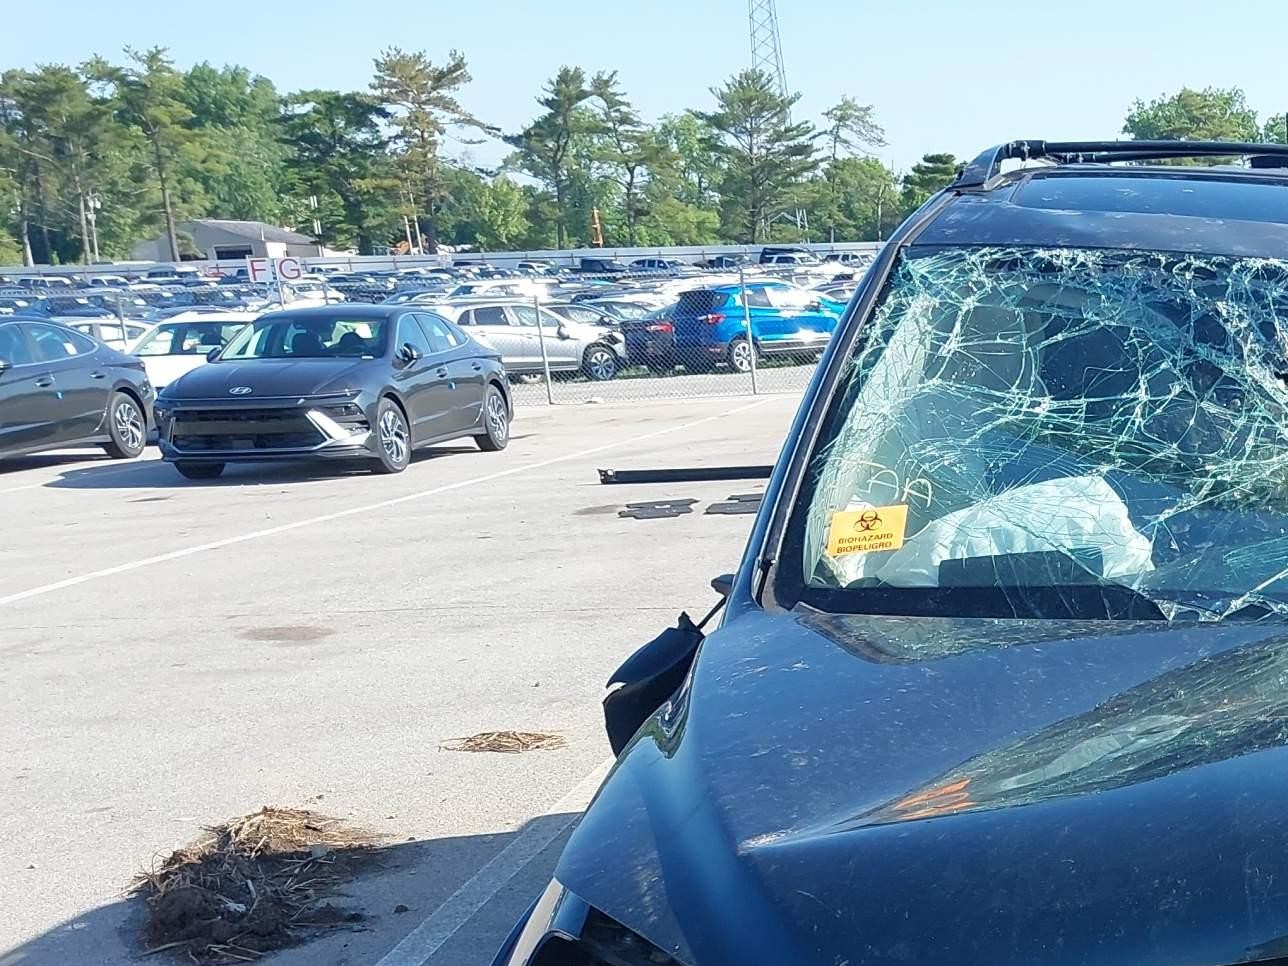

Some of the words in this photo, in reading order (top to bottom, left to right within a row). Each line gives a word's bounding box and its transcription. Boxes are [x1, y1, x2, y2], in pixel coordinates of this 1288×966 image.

[250, 259, 266, 281] F
[278, 258, 301, 280] G
[838, 532, 893, 544] BIOHAZARD
[837, 541, 892, 553] BIOPELIGRO
